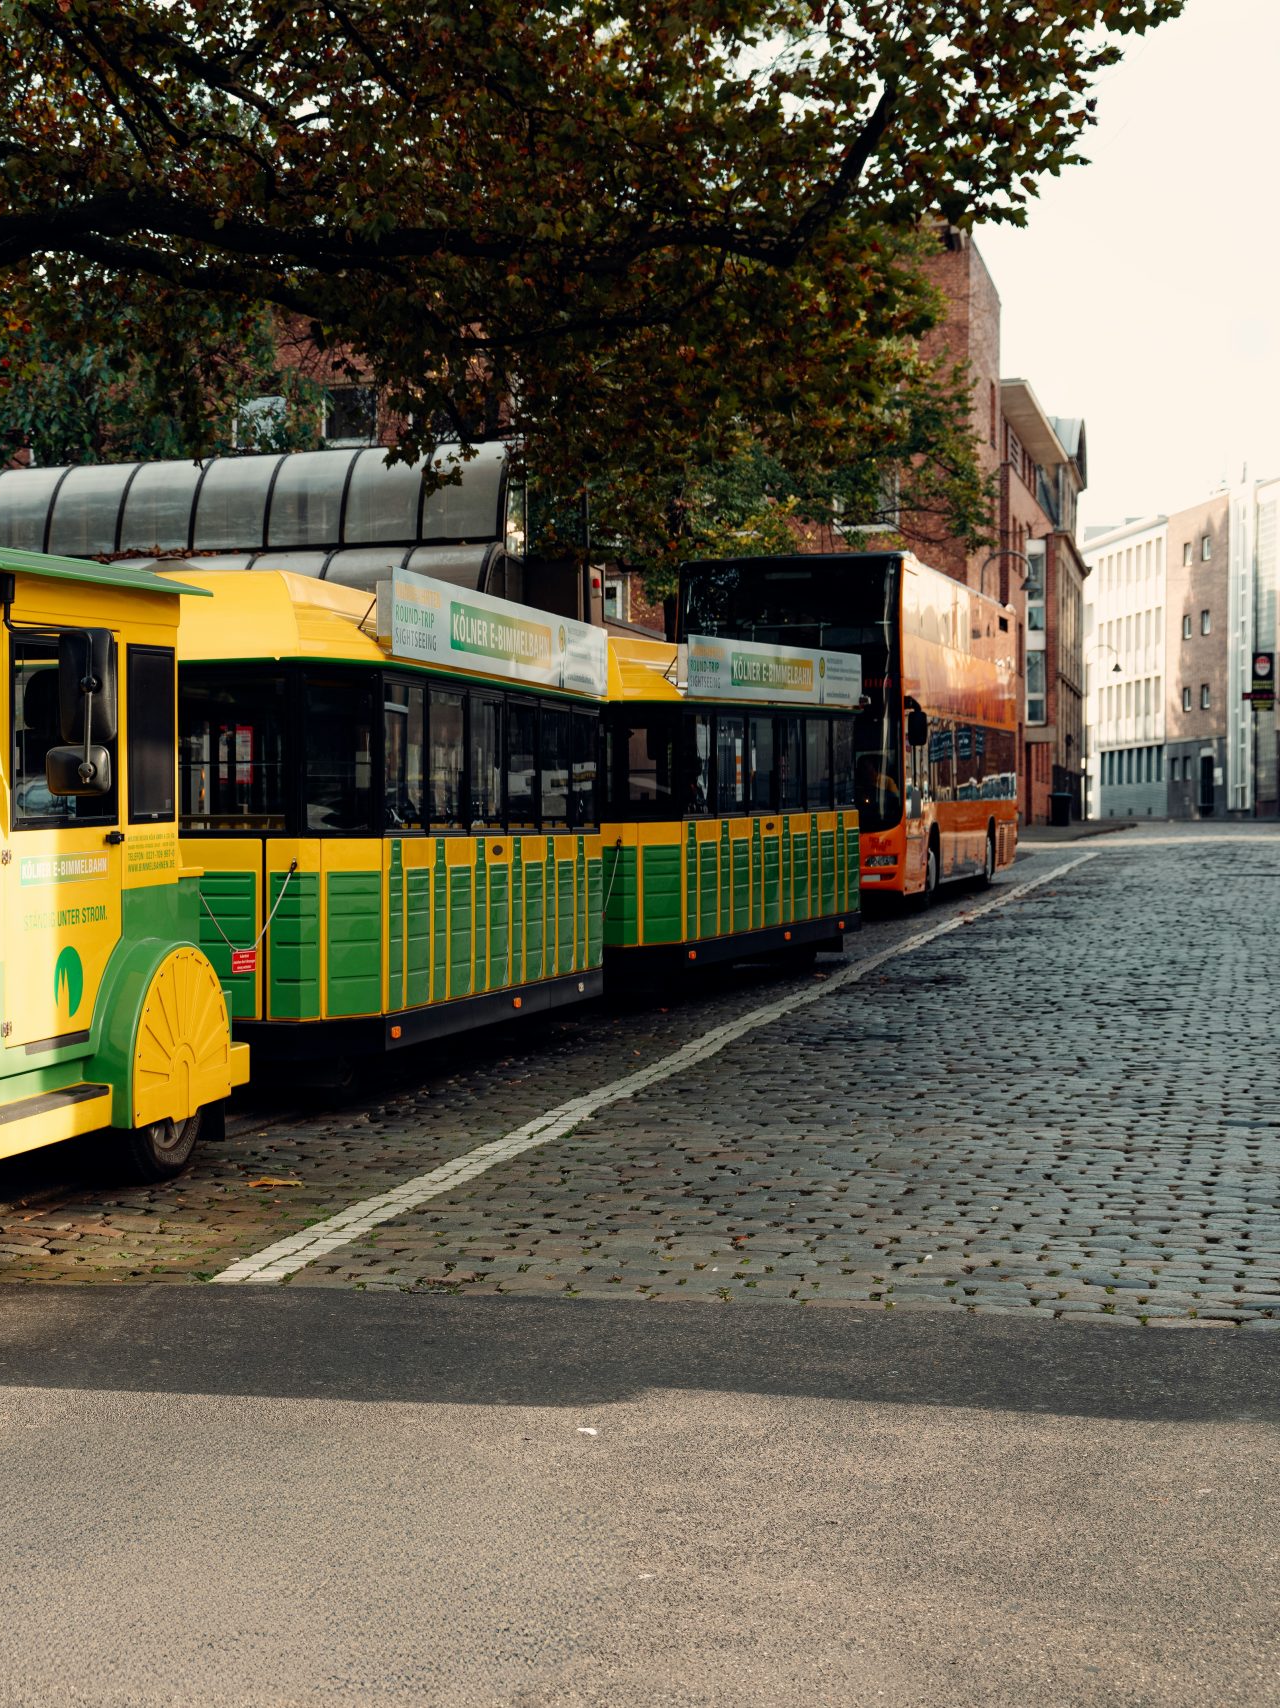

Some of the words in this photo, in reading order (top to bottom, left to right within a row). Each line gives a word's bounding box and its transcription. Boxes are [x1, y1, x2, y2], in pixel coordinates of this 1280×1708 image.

[395, 604, 435, 629] ROUND-TRIP
[395, 627, 437, 652] SIGHTSEEING
[453, 608, 488, 647] KÖLNER
[490, 622, 550, 658] E-BIMMELBAHN
[733, 656, 761, 682] KÖLNER
[762, 662, 812, 686] E-BIMMELBAHN
[53, 857, 107, 877] E-BIMMELBAHN
[57, 908, 80, 927] UNTER
[81, 904, 107, 923] STROM.
